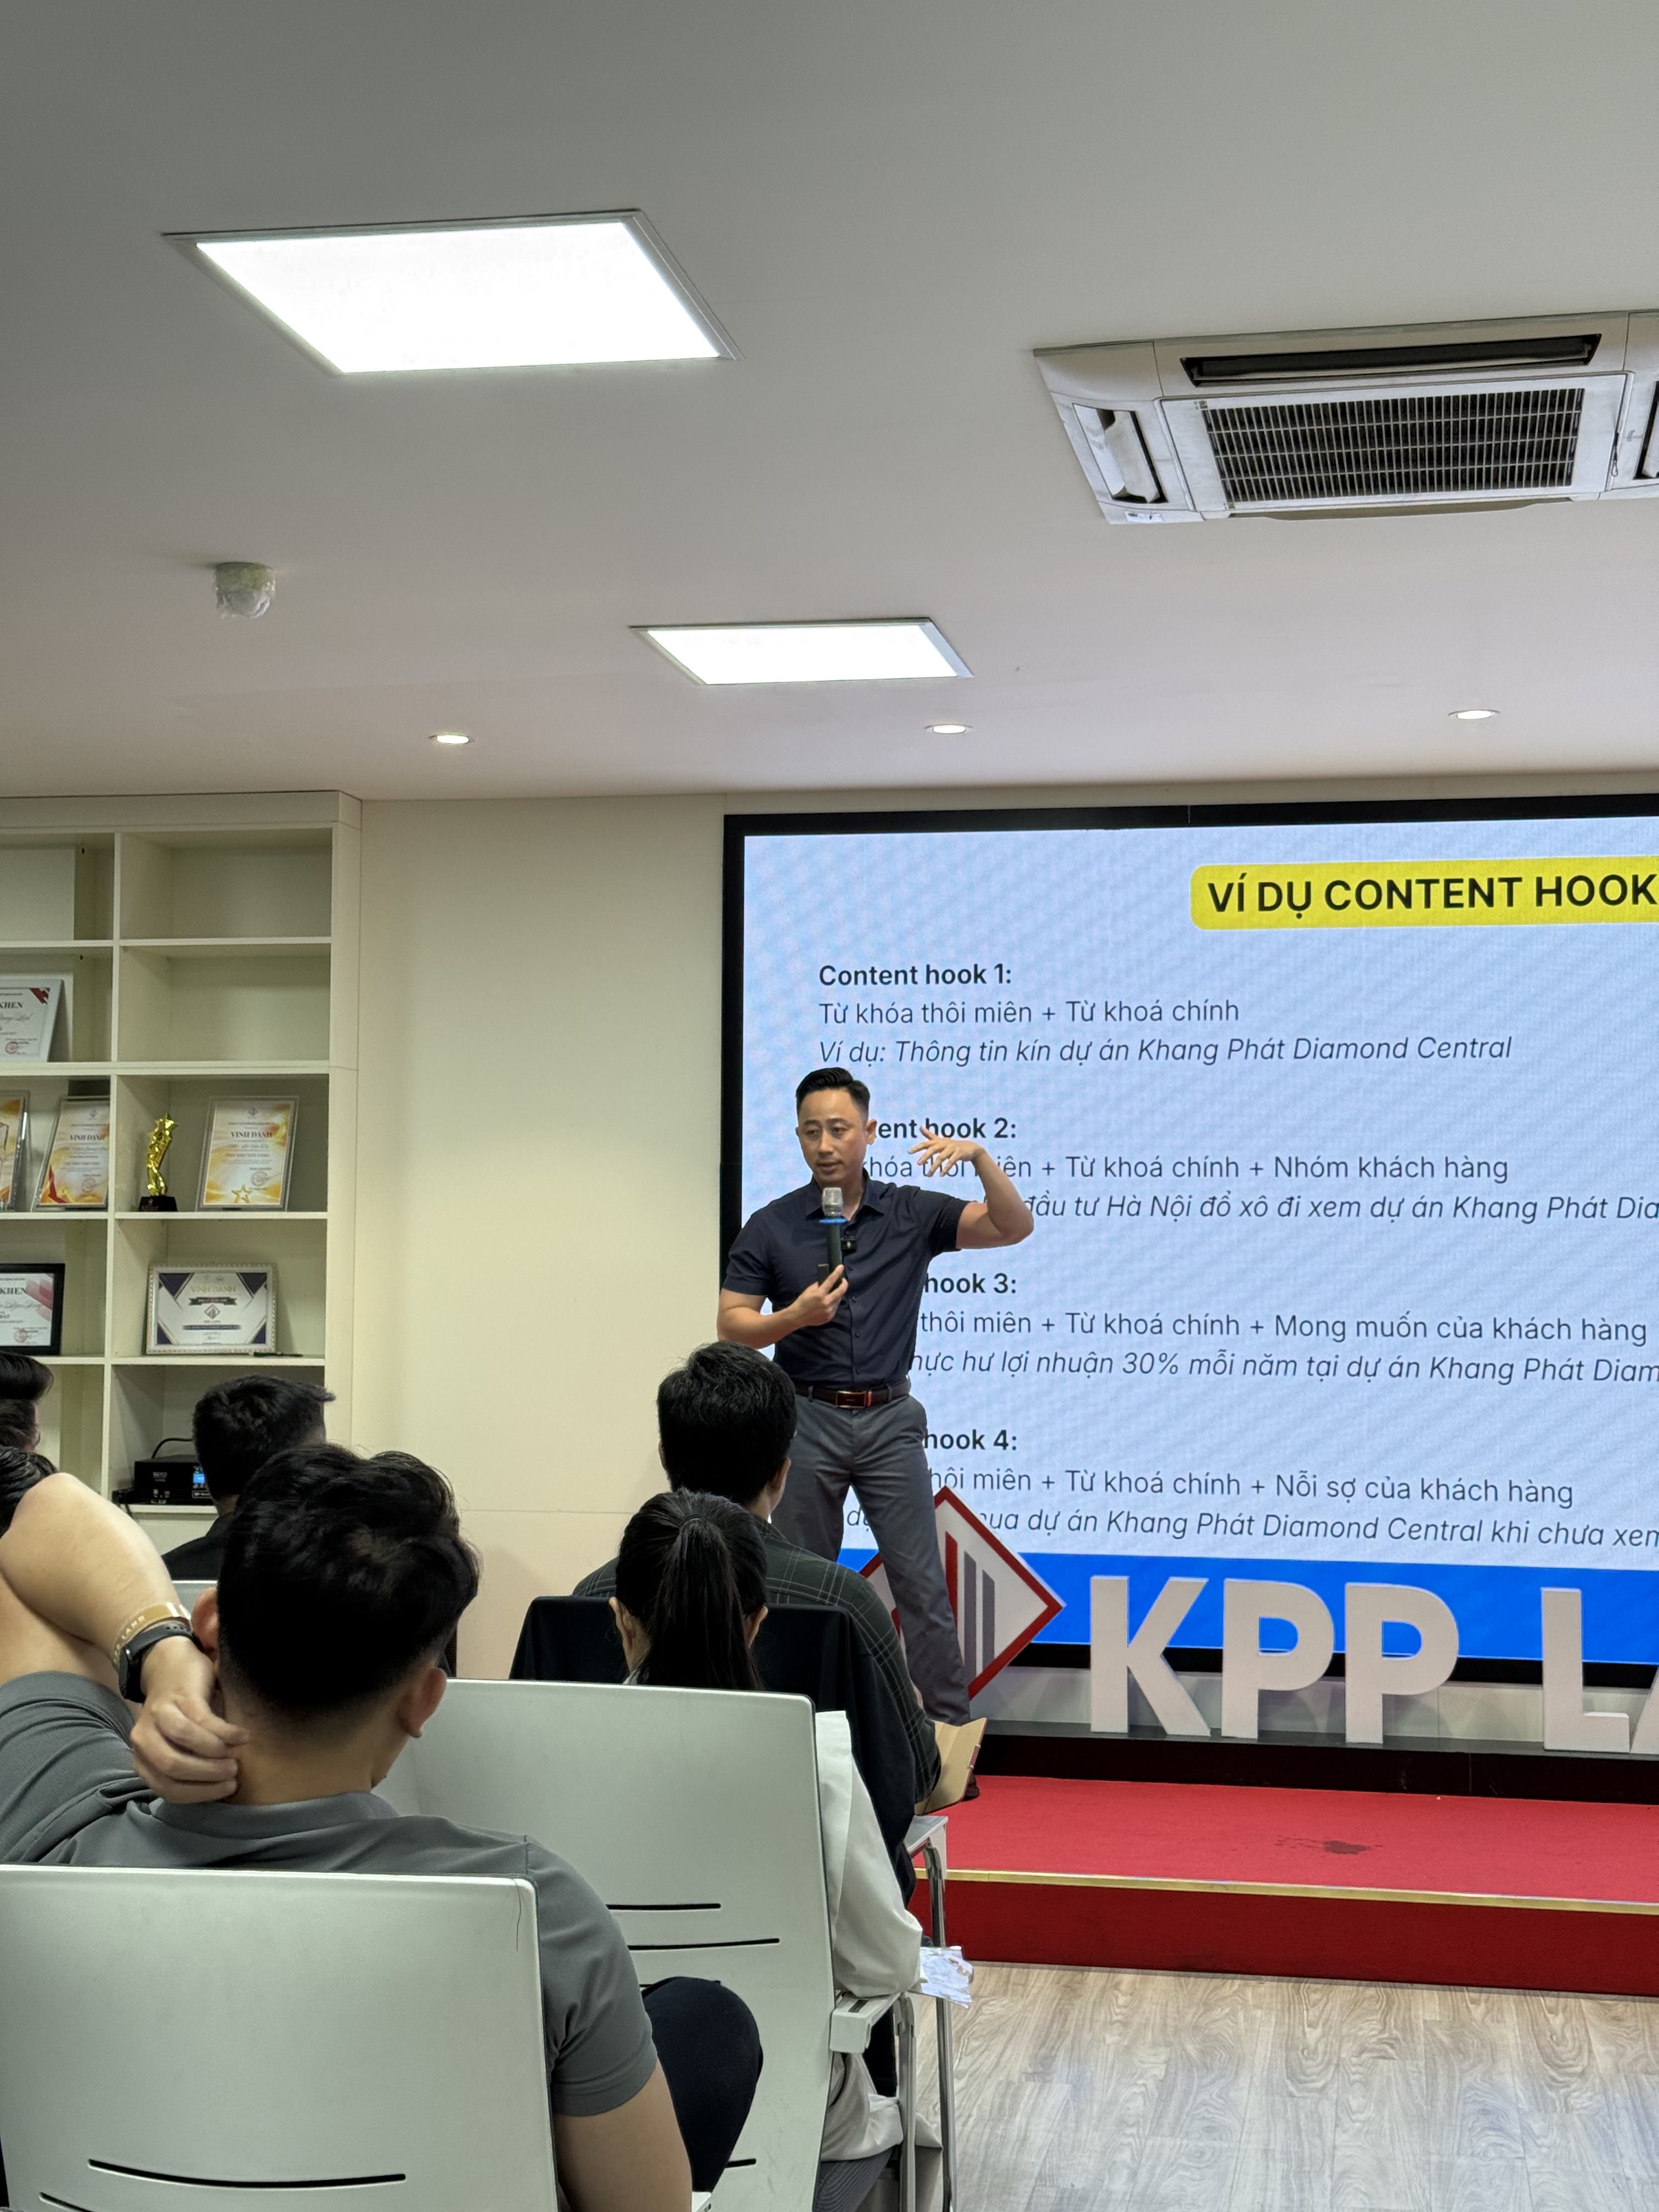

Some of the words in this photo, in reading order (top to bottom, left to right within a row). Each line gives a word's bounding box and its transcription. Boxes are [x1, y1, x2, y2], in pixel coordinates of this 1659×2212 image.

[1208, 873, 1246, 912] VÍ
[1259, 881, 1311, 919] DỤ
[1325, 877, 1522, 911] CONTENT
[1536, 874, 1657, 907] HOOK
[819, 965, 918, 986] Content
[926, 963, 987, 985] hook
[994, 963, 1011, 984] 1:
[819, 1002, 848, 1024] Từ
[857, 1002, 912, 1024] khóa
[921, 1001, 965, 1023] thôi
[975, 1001, 1031, 1023] miên
[1042, 1007, 1056, 1020] +
[1065, 1000, 1096, 1022] Từ
[1105, 999, 1162, 1022] khoá
[1172, 998, 1238, 1021] chính
[820, 1041, 843, 1062] Ví
[849, 1041, 885, 1067] dụ:
[895, 1040, 971, 1067] Thông
[980, 1040, 1007, 1061] tin
[1016, 1039, 1050, 1061] kín
[1060, 1040, 1092, 1066] dự
[1099, 1039, 1128, 1060] án
[1138, 1039, 1218, 1065] Khang
[1228, 1037, 1285, 1060] Phát
[1294, 1037, 1408, 1059] Diamond
[1418, 1036, 1512, 1058] Central
[994, 1117, 1016, 1138] 2:
[1042, 1162, 1055, 1176] +
[1065, 1155, 1095, 1177] Từ
[1105, 1155, 1162, 1177] khoá
[1172, 1155, 1238, 1177] chính
[1250, 1162, 1263, 1176] +
[1275, 1155, 1347, 1178] Nhóm
[1359, 1155, 1434, 1178] khách
[1445, 1155, 1508, 1184] hàng
[1075, 1197, 1100, 1216] tư
[1107, 1194, 1141, 1216] Hà
[1150, 1195, 1192, 1222] Nội
[1200, 1190, 1231, 1217] đổ
[1238, 1195, 1268, 1217] xô
[1278, 1195, 1301, 1217] đi
[1307, 1201, 1361, 1217] xem
[1370, 1196, 1405, 1223] dự
[1412, 1195, 1443, 1218] án
[1453, 1196, 1537, 1224] Khang
[1547, 1196, 1609, 1218] Phát
[924, 1273, 986, 1294] hook
[994, 1273, 1016, 1294] 3:
[921, 1311, 964, 1333] thôi
[974, 1311, 1031, 1333] miên
[1042, 1318, 1055, 1332] +
[1065, 1312, 1095, 1334] Từ
[1105, 1313, 1163, 1335] khoá
[1173, 1313, 1239, 1335] chính
[1250, 1320, 1264, 1334] +
[1276, 1314, 1345, 1342] Mong
[1357, 1311, 1427, 1338] muốn
[1437, 1316, 1482, 1339] của
[1493, 1317, 1571, 1340] khách
[1582, 1318, 1646, 1347] hàng
[913, 1352, 955, 1377] ực
[963, 1350, 995, 1372] hư
[1002, 1351, 1029, 1378] lợi
[1037, 1351, 1113, 1379] nhuận
[1122, 1352, 1178, 1374] 30%
[1189, 1349, 1235, 1375] mỗi
[1243, 1353, 1297, 1376] năm
[1307, 1355, 1339, 1382] tại
[1347, 1356, 1381, 1383] dự
[1389, 1355, 1420, 1378] án
[1430, 1357, 1514, 1385] Khang
[1523, 1358, 1584, 1380] Phát
[924, 1430, 986, 1450] hook
[994, 1430, 1017, 1451] 4:
[930, 1467, 964, 1489] hôi
[974, 1468, 1030, 1491] miên
[1042, 1475, 1055, 1489] +
[1065, 1469, 1096, 1492] Từ
[1105, 1470, 1163, 1493] khoá
[1173, 1472, 1240, 1495] chính
[1251, 1480, 1265, 1494] +
[1277, 1470, 1317, 1497] Nỗi
[1327, 1478, 1356, 1503] sợ
[1365, 1476, 1410, 1499] của
[1421, 1477, 1498, 1502] khách
[1509, 1479, 1572, 1509] hàng
[1028, 1509, 1060, 1536] dự
[1068, 1509, 1097, 1532] án
[1107, 1510, 1188, 1539] Khang
[1197, 1513, 1255, 1536] Phát
[1263, 1514, 1379, 1539] Diamond
[1388, 1517, 1482, 1542] Central
[1491, 1520, 1530, 1543] khi
[1538, 1522, 1604, 1545] chưa
[1090, 1575, 1459, 1743] KPP
